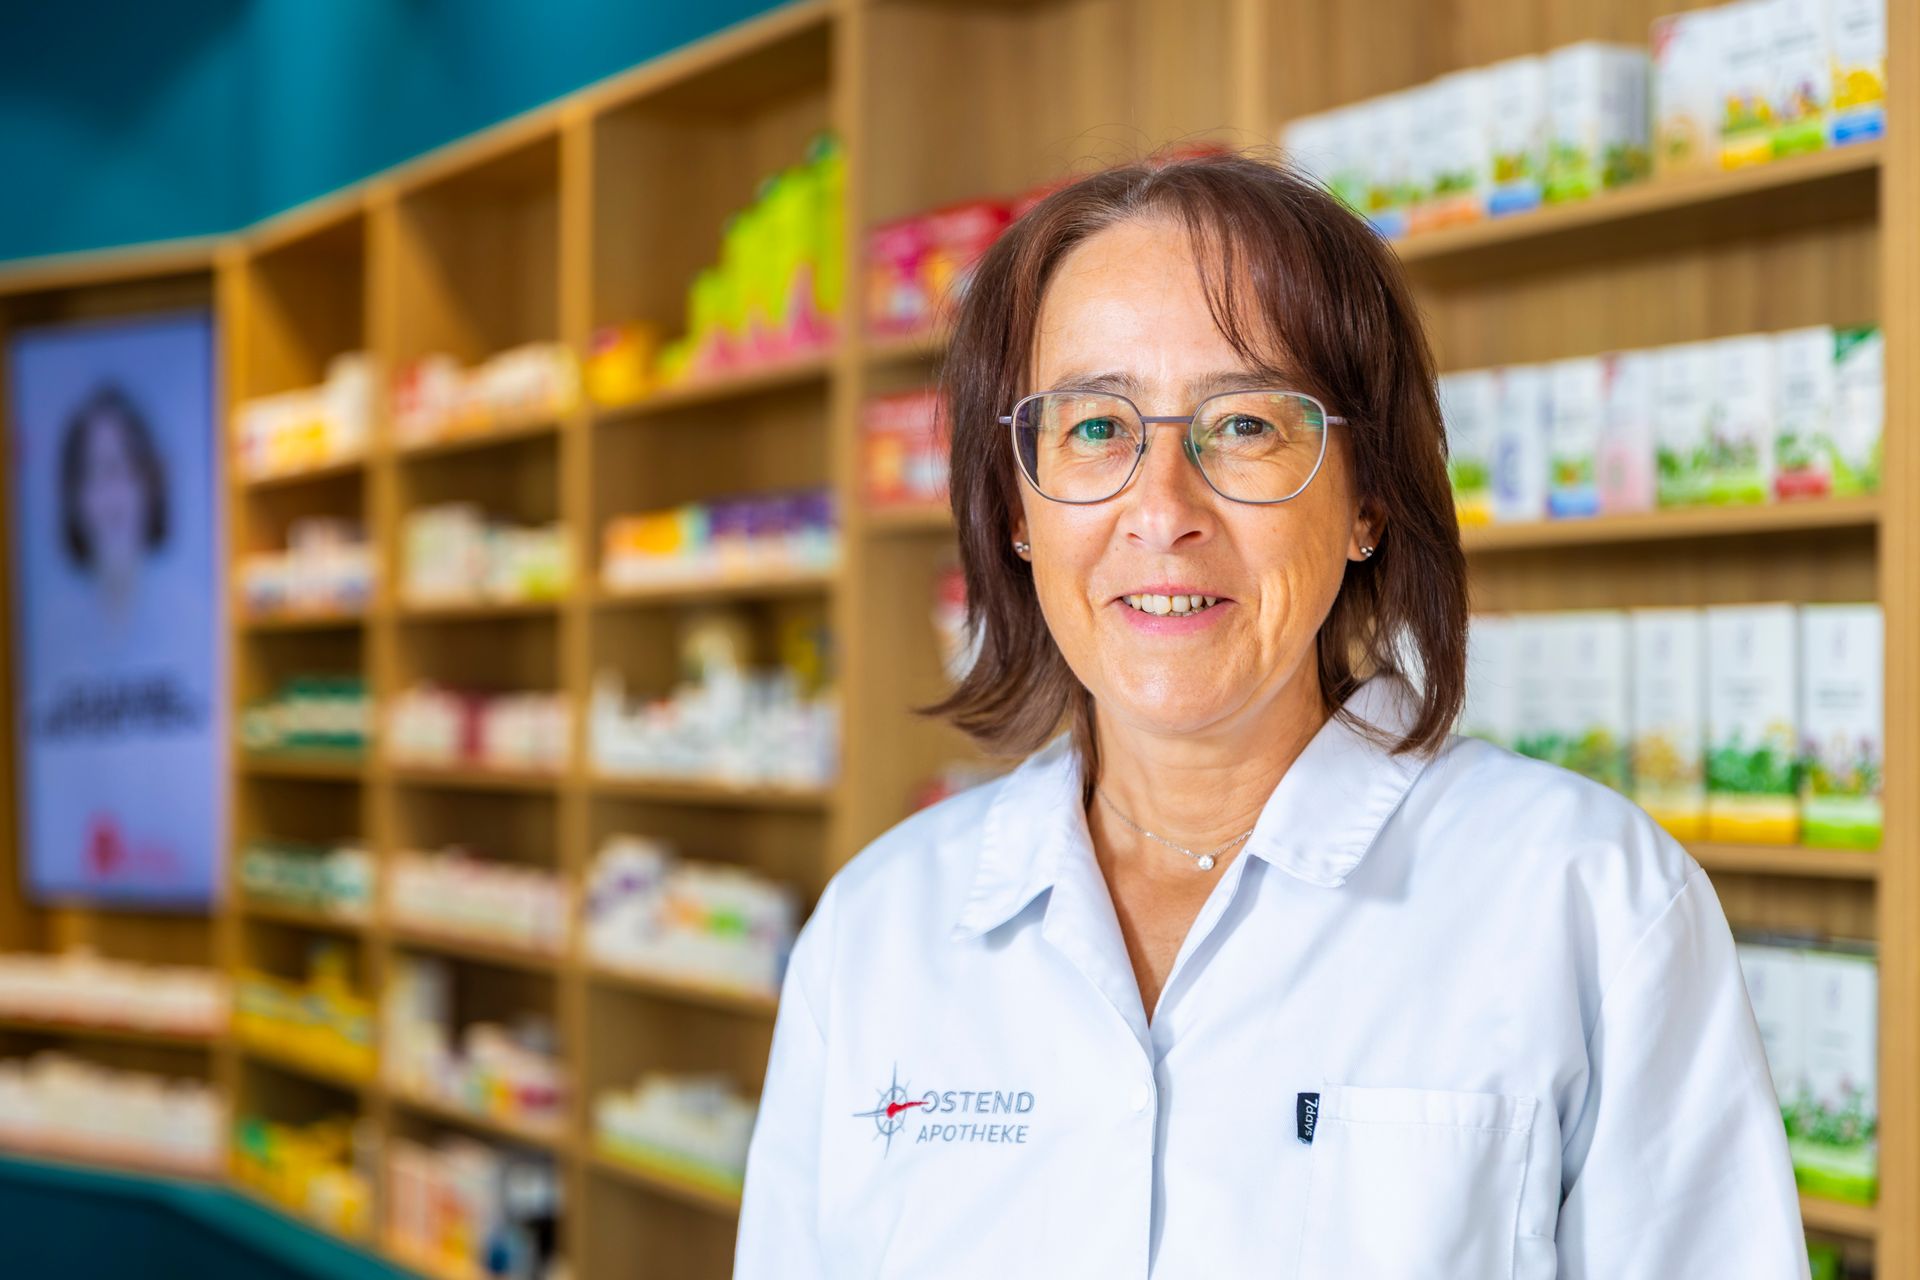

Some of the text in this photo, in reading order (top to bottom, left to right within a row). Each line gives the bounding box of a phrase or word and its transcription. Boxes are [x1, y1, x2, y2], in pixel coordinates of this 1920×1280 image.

[921, 1090, 1035, 1114] OSTEND
[1304, 1098, 1319, 1137] 7days
[916, 1123, 1030, 1144] APOTHEKE
